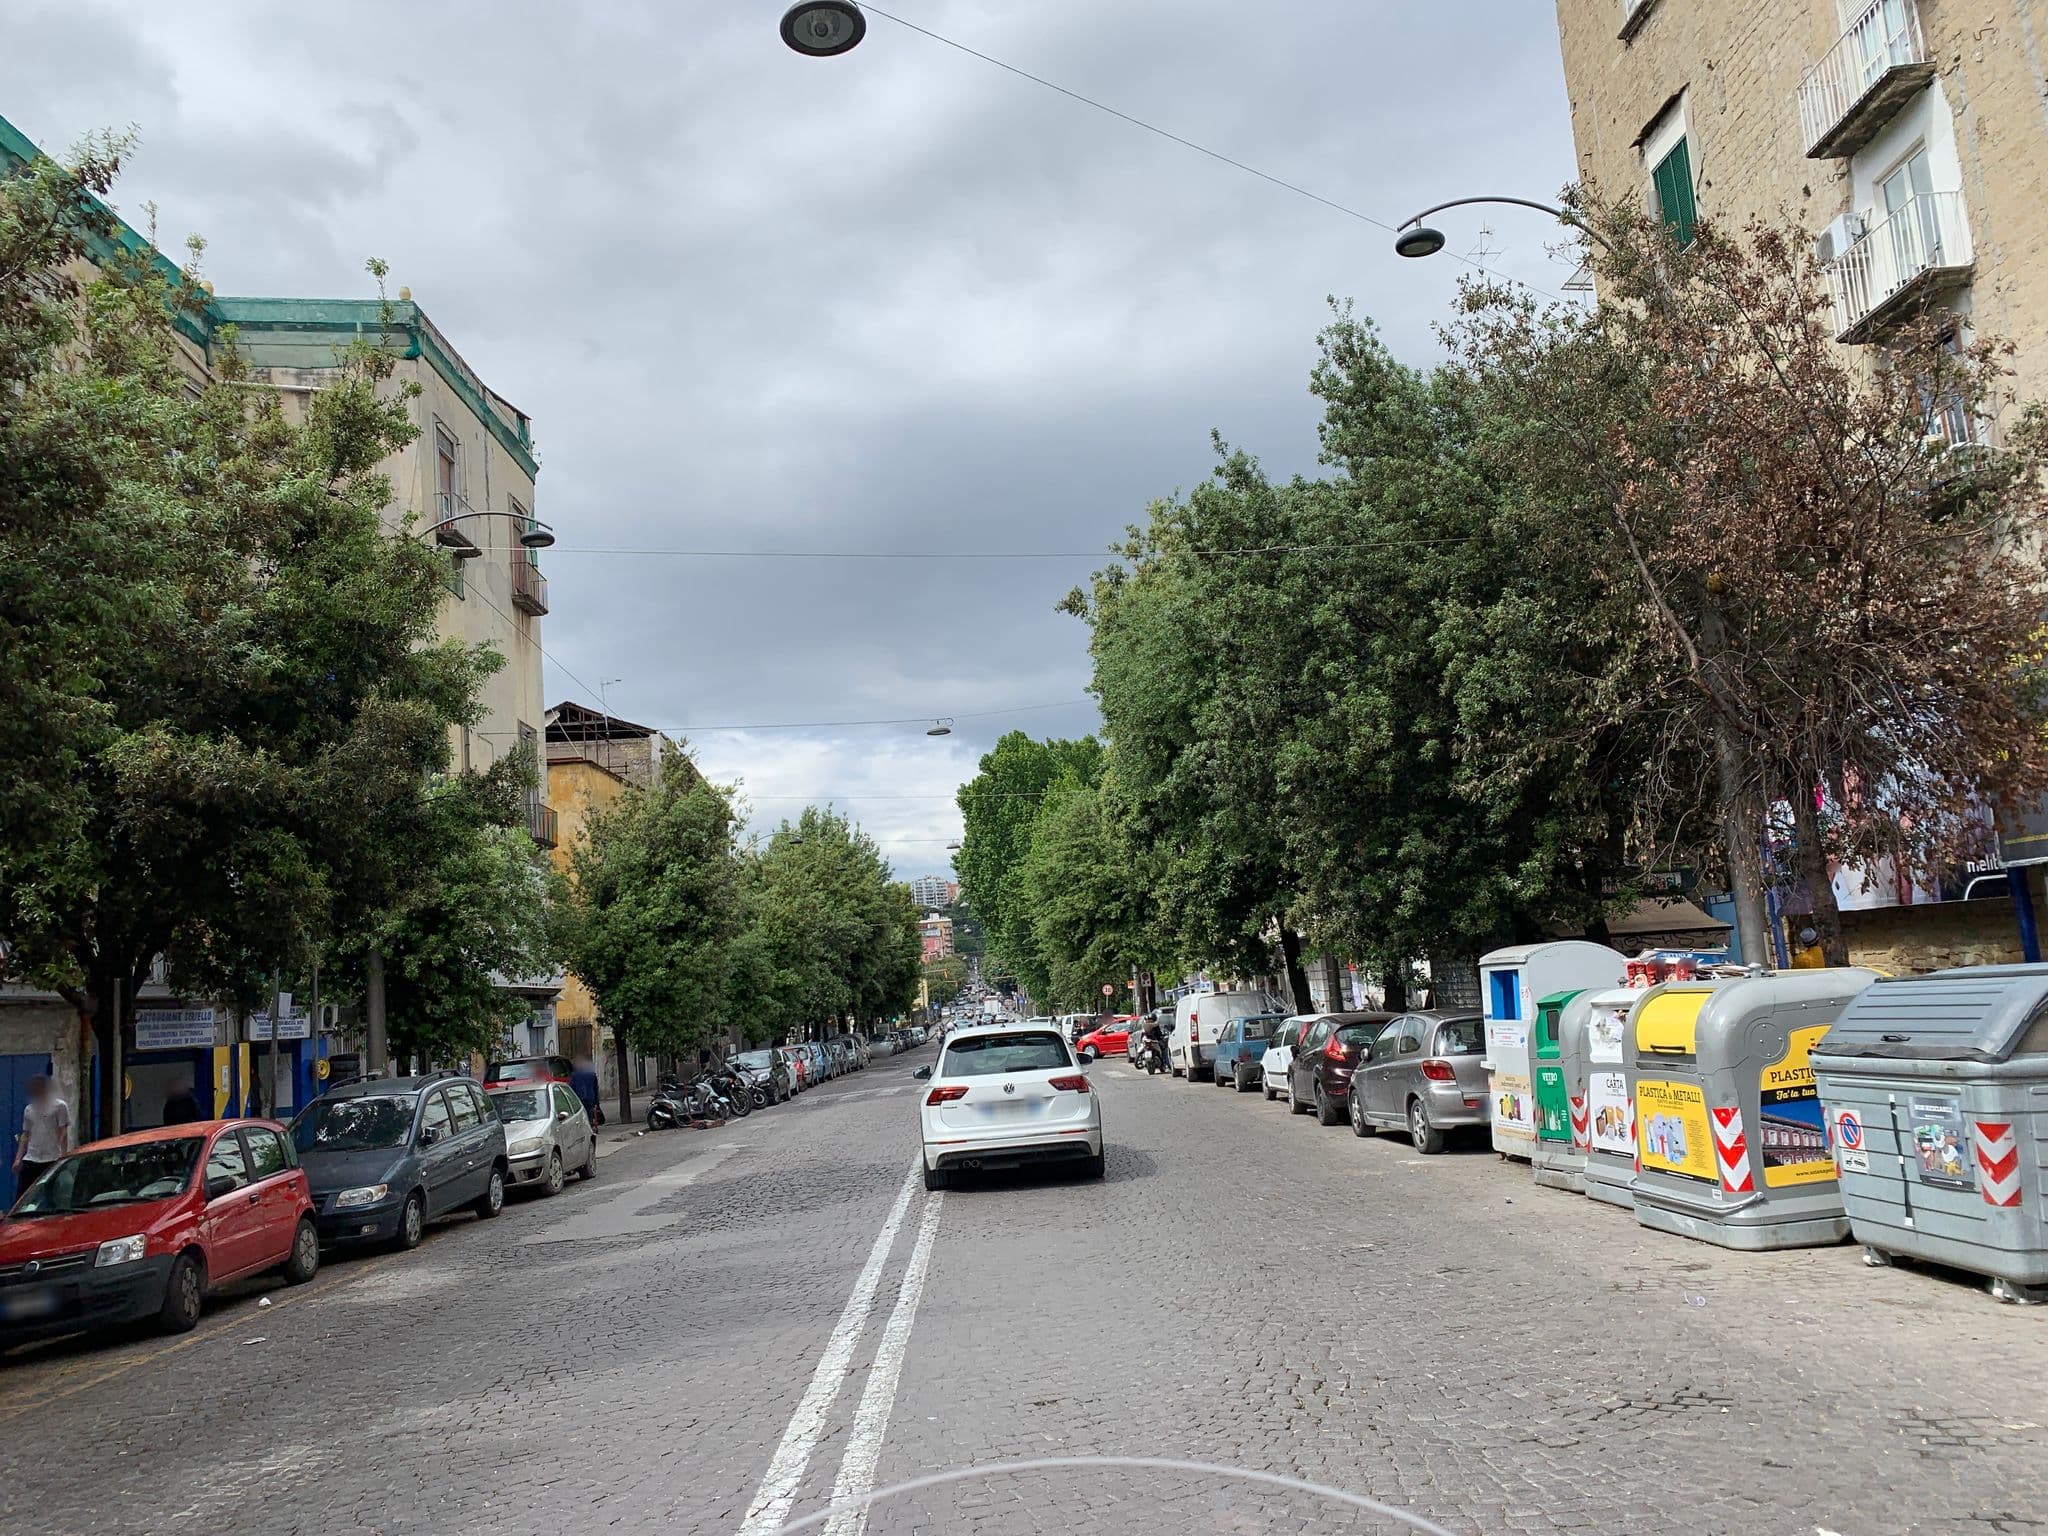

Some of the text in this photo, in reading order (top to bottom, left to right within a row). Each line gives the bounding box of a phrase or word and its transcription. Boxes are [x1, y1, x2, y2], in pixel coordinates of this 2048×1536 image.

[1541, 1072, 1558, 1082] VETRO
[1606, 1079, 1624, 1090] CARTA
[1639, 1086, 1667, 1099] PLASTICA
[1673, 1090, 1701, 1104] METALLI
